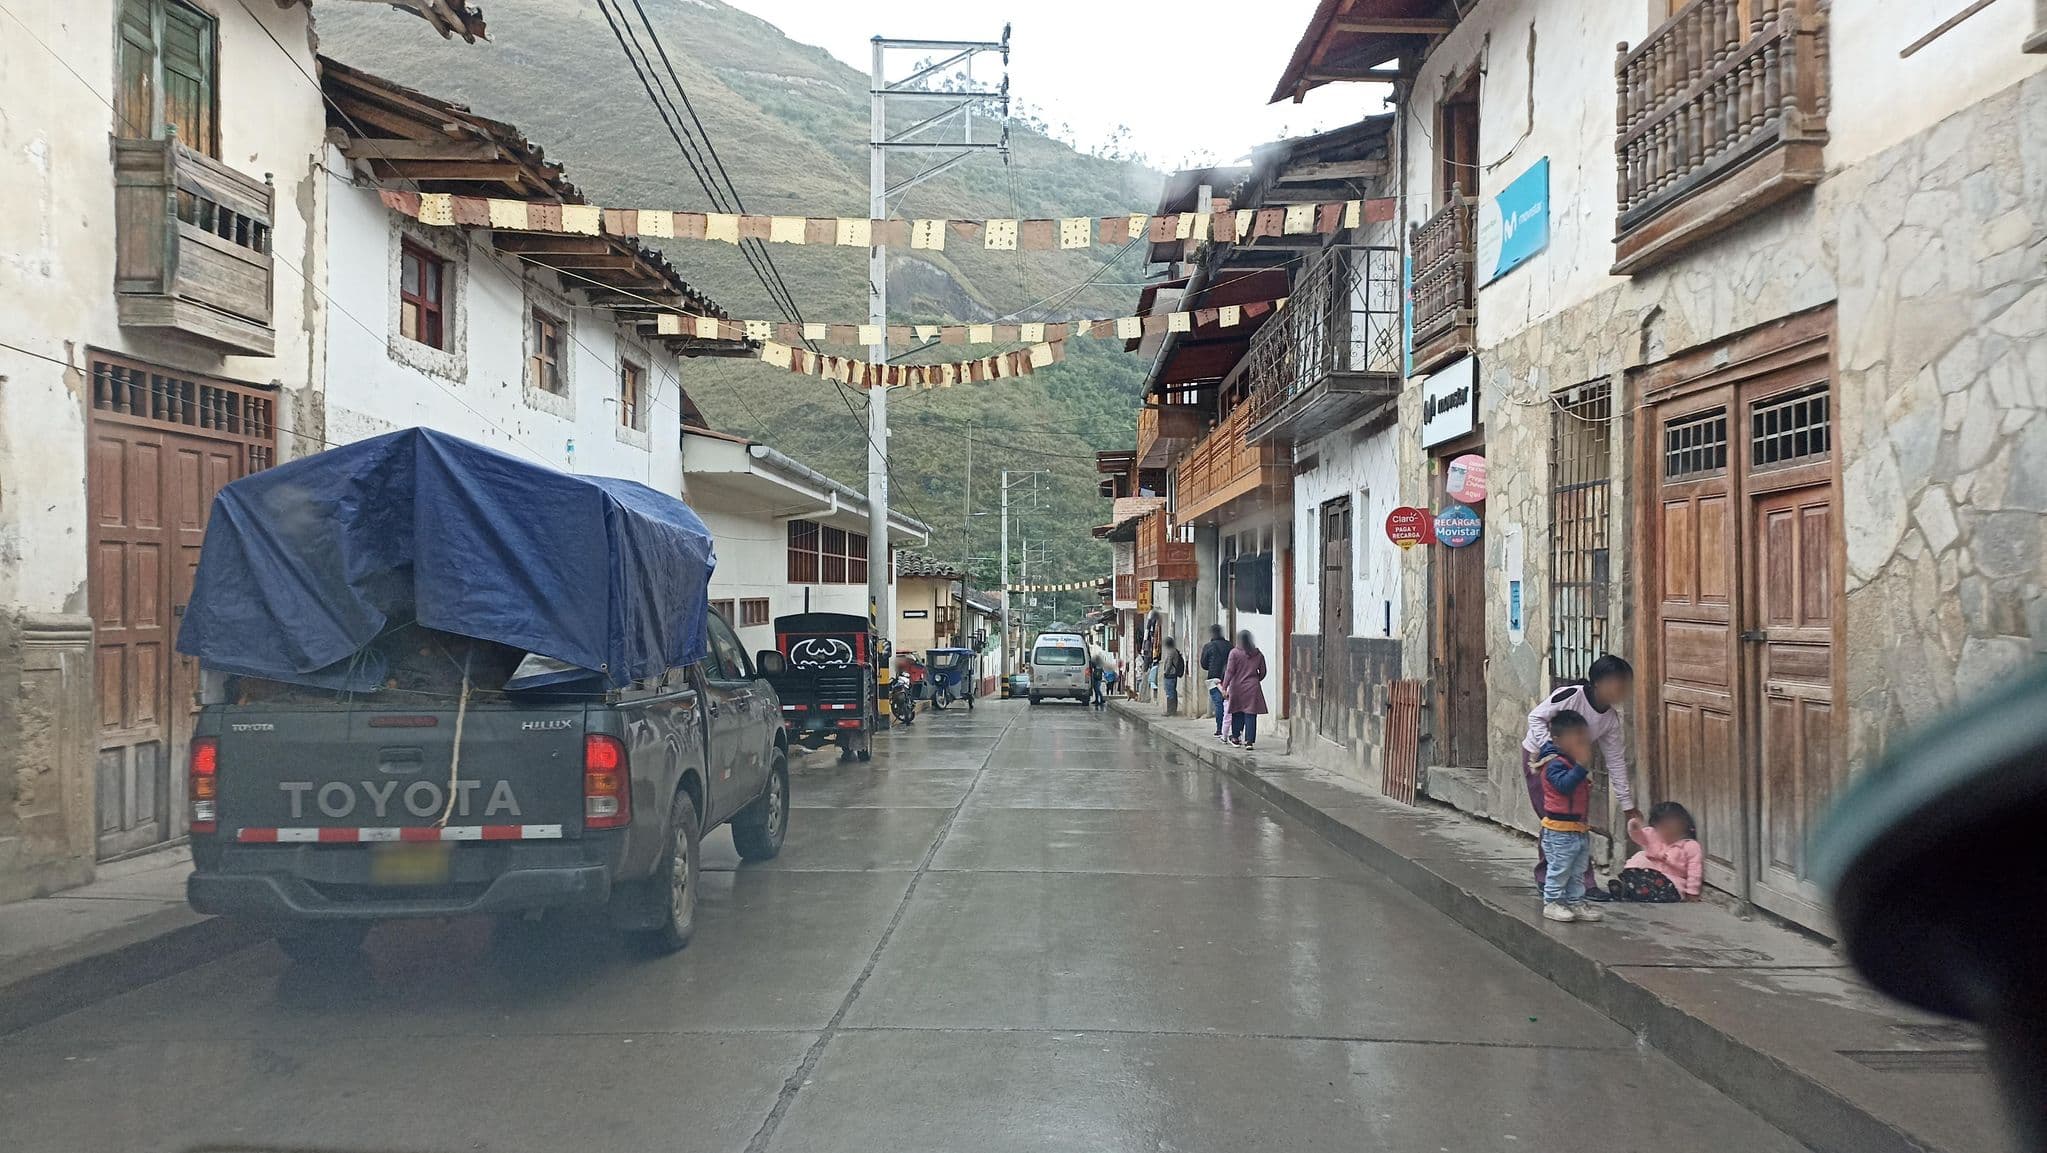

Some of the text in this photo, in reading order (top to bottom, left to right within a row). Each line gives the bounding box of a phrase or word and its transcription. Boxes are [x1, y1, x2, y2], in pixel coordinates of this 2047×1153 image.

[1392, 513, 1416, 523] Claro
[1434, 518, 1482, 527] RECARGAS
[1436, 527, 1481, 536] Movistar
[231, 723, 274, 732] TOYOTA
[521, 719, 572, 731] HILUX
[279, 779, 521, 819] TOYOTA
